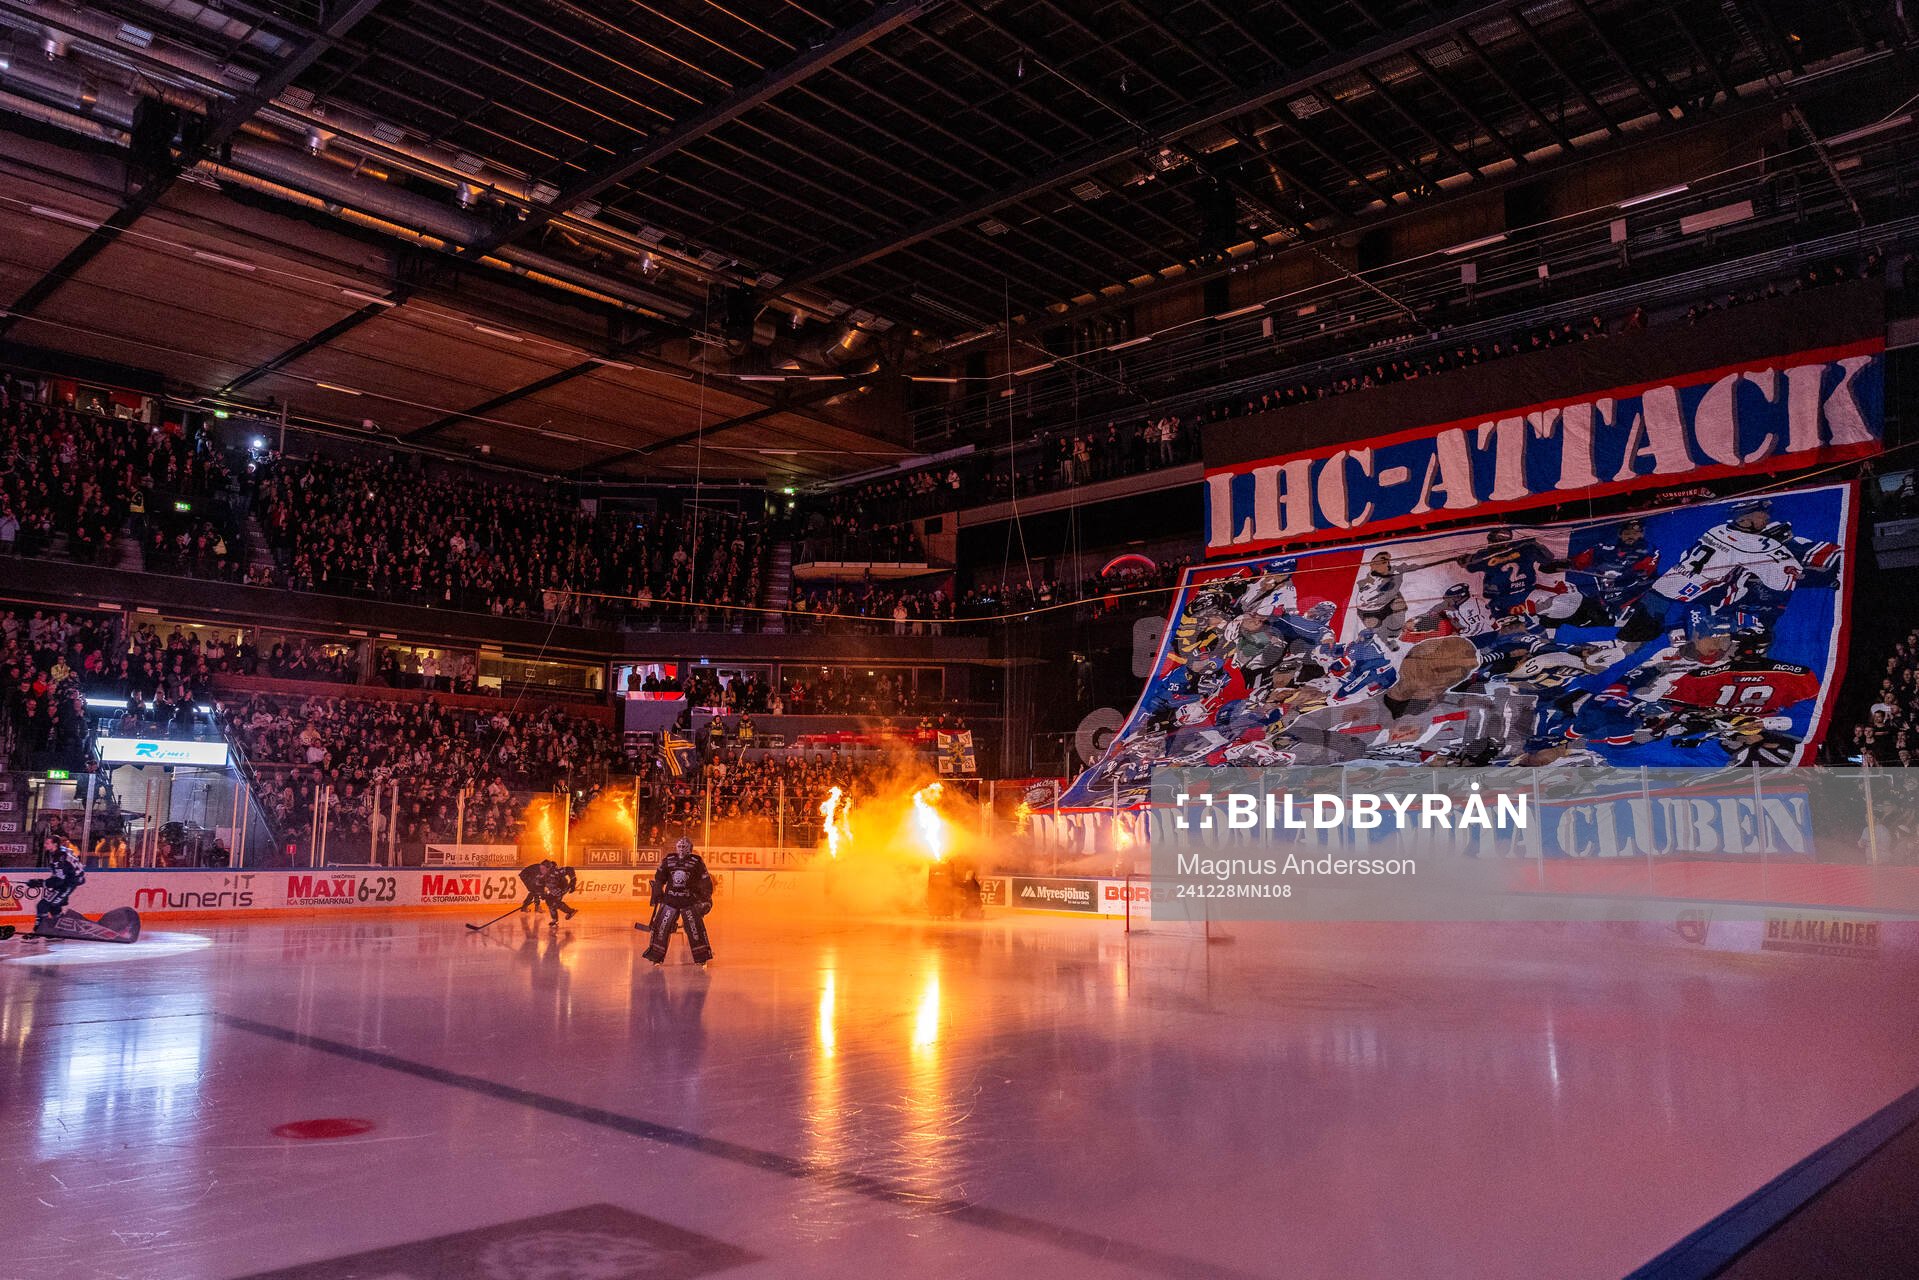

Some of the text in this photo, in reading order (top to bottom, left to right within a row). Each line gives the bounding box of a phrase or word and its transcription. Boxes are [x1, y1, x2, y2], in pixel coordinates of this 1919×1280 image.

[1206, 355, 1875, 548] LHC-ATTACK
[1555, 796, 1808, 858] CLUBEN
[591, 851, 621, 862] MABI
[358, 876, 397, 902] 6-23
[483, 876, 517, 900] 6-23
[1037, 885, 1090, 902] Myresjöhus
[299, 896, 354, 906] STORMARKNAD
[1767, 913, 1881, 946] BLÅKLÄDER
